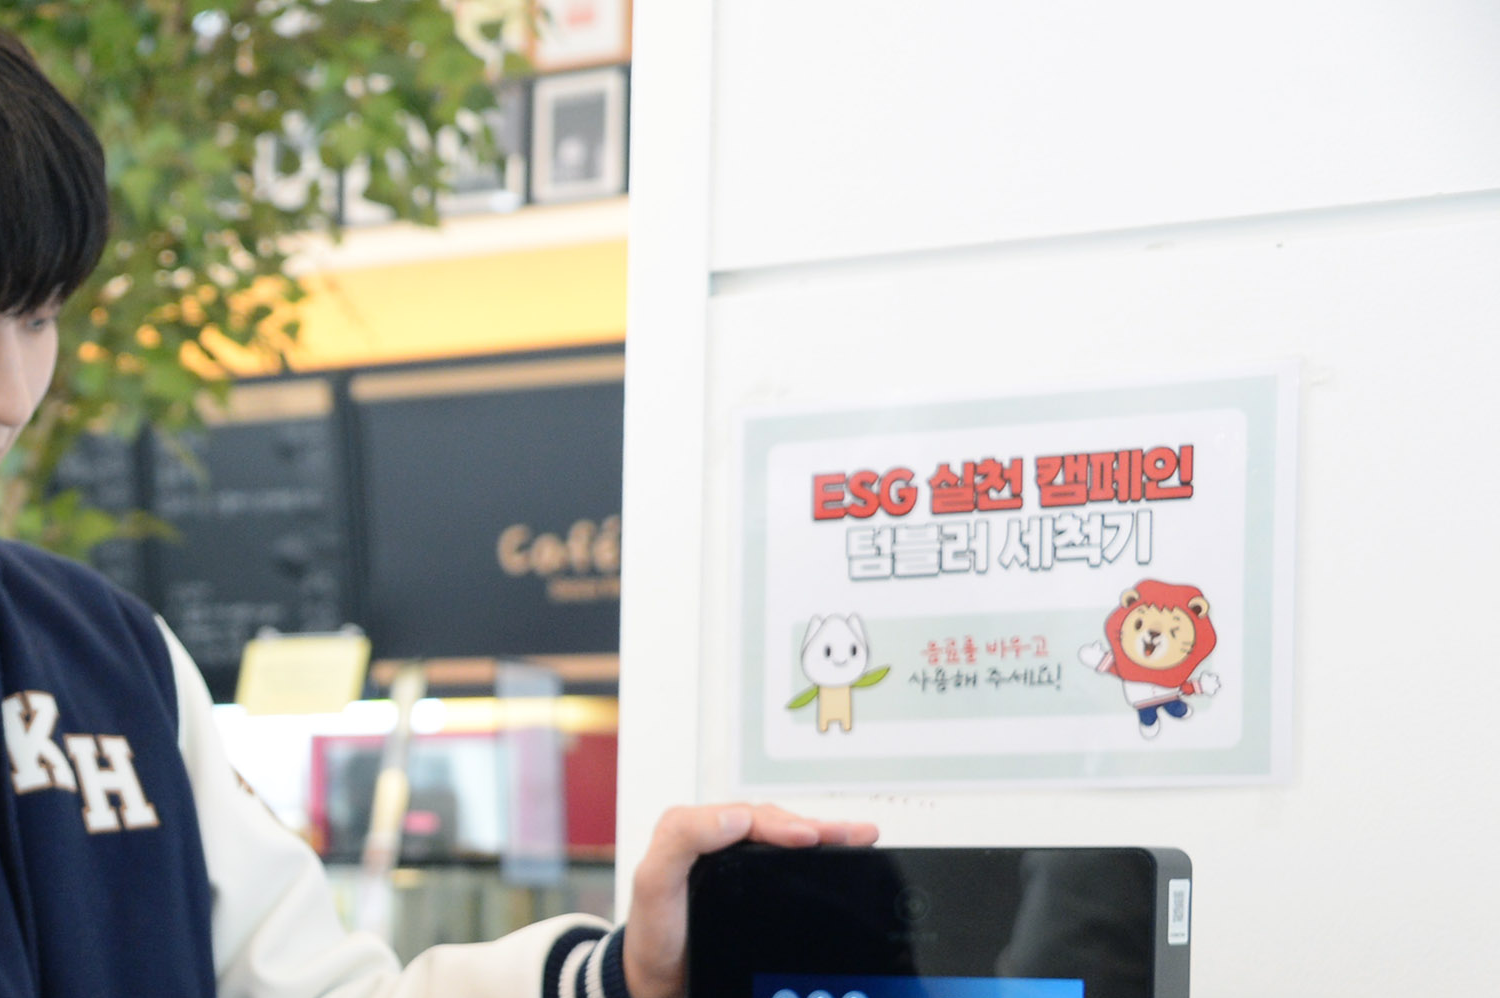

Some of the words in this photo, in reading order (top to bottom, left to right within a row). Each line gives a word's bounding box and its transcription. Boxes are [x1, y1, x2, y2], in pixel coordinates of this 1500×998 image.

[812, 468, 918, 521] ESG
[928, 457, 1024, 514] 실천
[1035, 444, 1195, 508] 캠페인
[845, 520, 990, 581] 텀블러
[997, 509, 1154, 573] 세척기
[920, 634, 978, 666] 음료를
[908, 667, 978, 693] 사용해
[985, 663, 1062, 692] 주세요!
